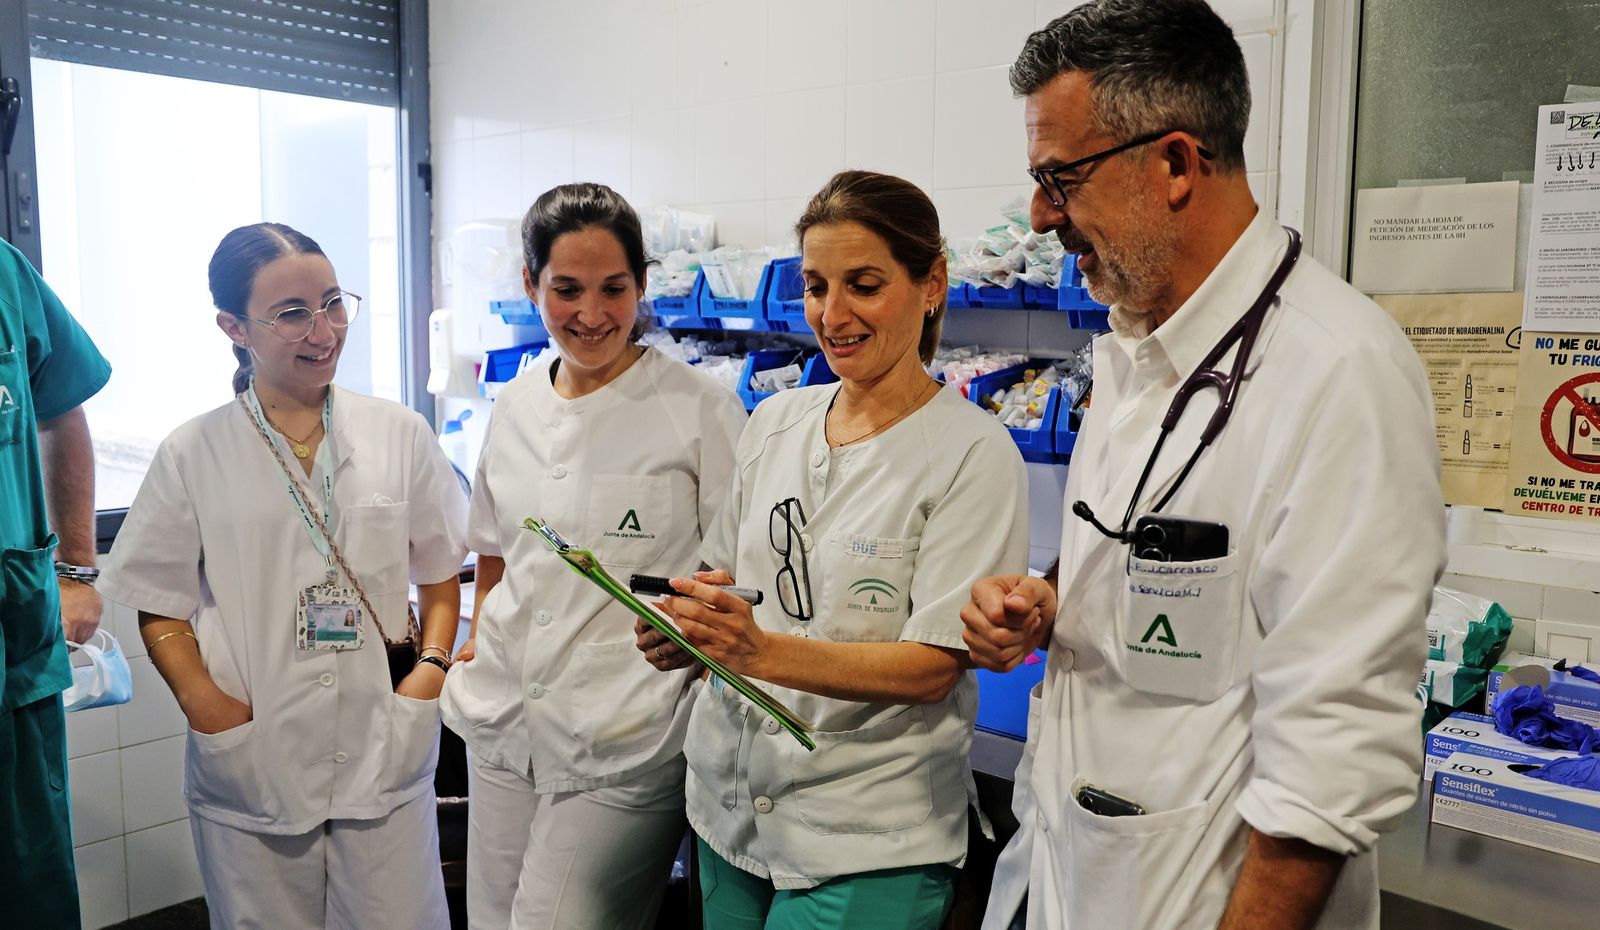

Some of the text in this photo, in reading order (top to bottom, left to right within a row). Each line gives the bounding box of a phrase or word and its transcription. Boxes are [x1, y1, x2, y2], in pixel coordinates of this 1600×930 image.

[1373, 215, 1464, 226] NO MANDAR LA HOJA DE
[1369, 221, 1495, 234] PETICIÓN DE MEDICACIÓN DE LOS
[1368, 233, 1406, 241] INGRESOS
[1406, 232, 1432, 241] ANTES
[1432, 232, 1443, 240] DE
[1455, 231, 1466, 239] 8H
[1405, 326, 1505, 335] EL ETIQUETADO DE NORADRENALINA
[1535, 337, 1554, 349] NO
[1559, 338, 1580, 350] ME
[1549, 353, 1568, 365] TU
[1527, 476, 1538, 486] SI
[1541, 477, 1555, 487] NO
[1559, 478, 1576, 489] ME
[1513, 487, 1586, 502] DEVUÉLVEME
[1521, 500, 1566, 514] CENTRO
[1568, 505, 1584, 515] DE
[852, 541, 878, 556] DUE
[846, 602, 863, 611] JUNTA
[864, 604, 872, 612] DE
[1145, 646, 1157, 655] de
[1158, 648, 1202, 660] Andalucía
[1555, 694, 1572, 704] nitrilo
[1581, 699, 1598, 708] polvo
[1441, 726, 1480, 738] 100
[1432, 738, 1461, 751] Sens
[1451, 763, 1494, 777] 100
[1440, 786, 1558, 820] Guantes de examen de nitrilo sin polvo
